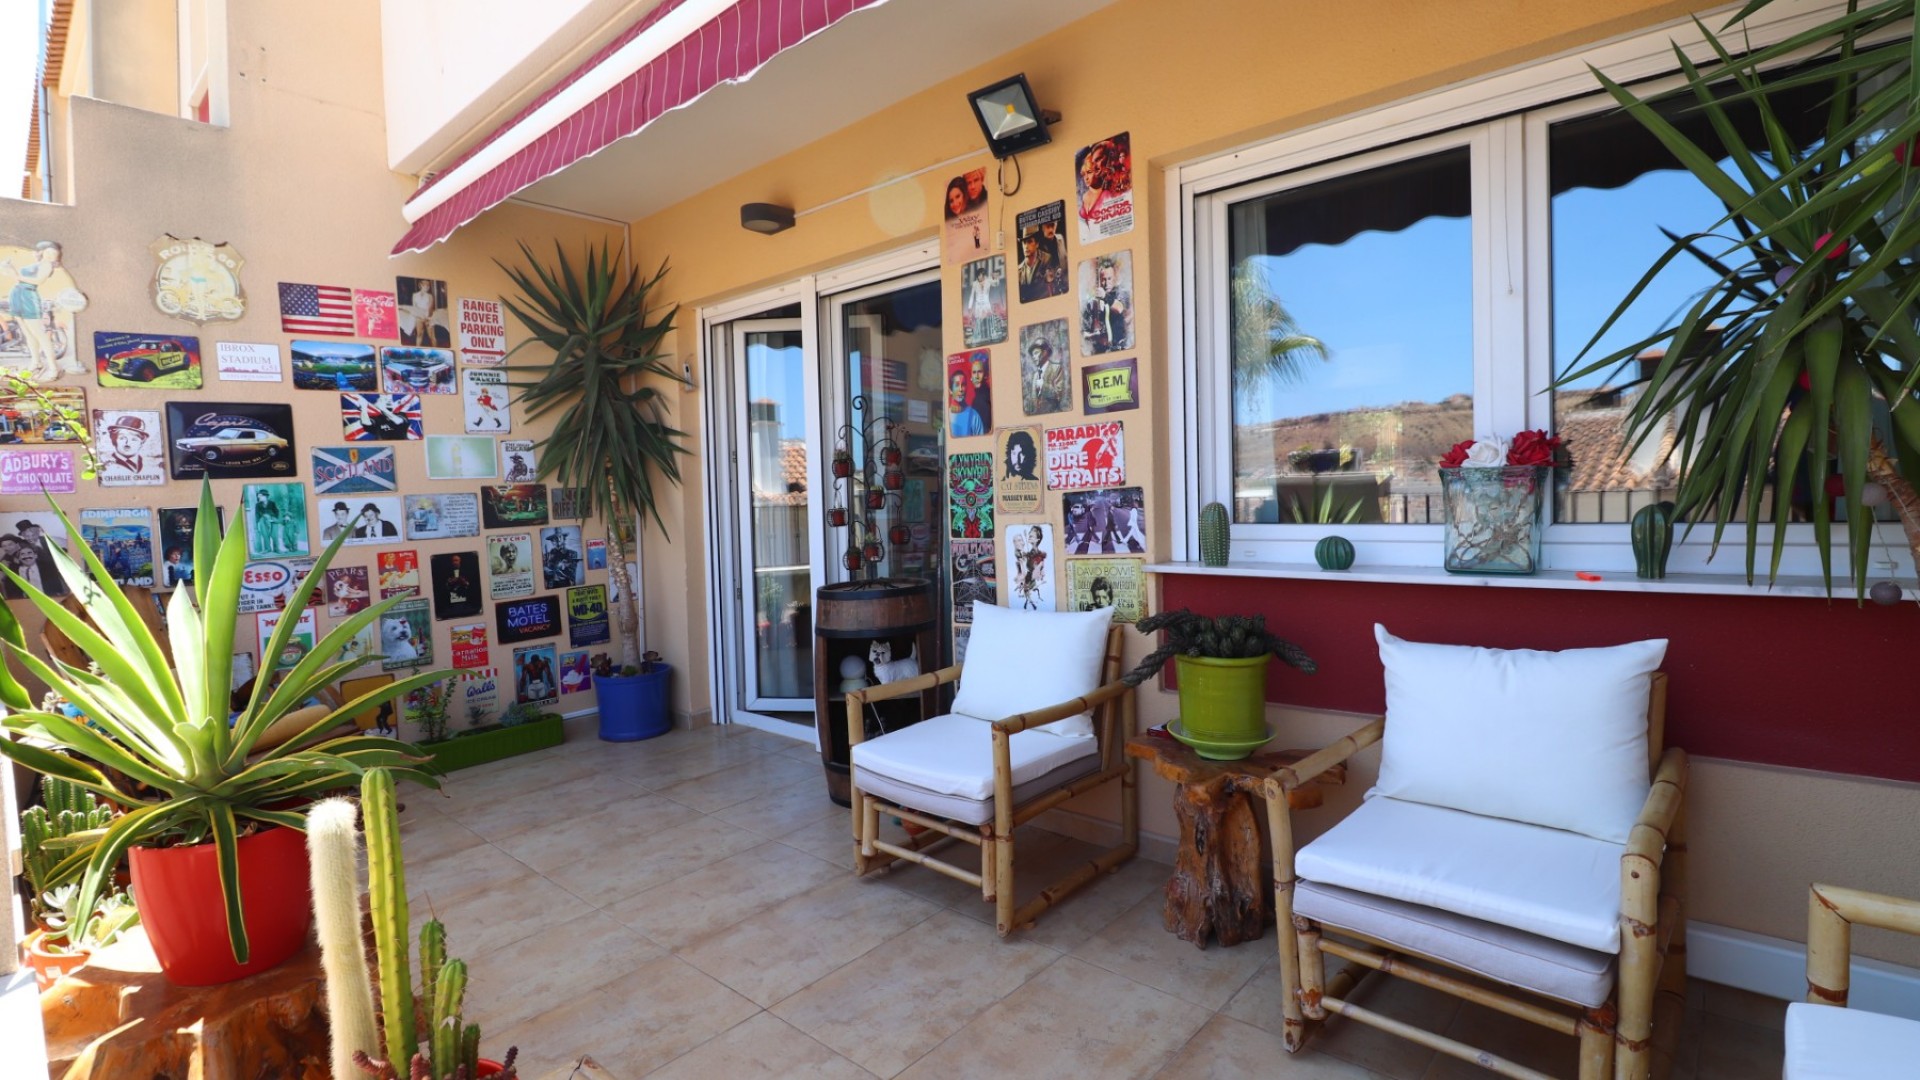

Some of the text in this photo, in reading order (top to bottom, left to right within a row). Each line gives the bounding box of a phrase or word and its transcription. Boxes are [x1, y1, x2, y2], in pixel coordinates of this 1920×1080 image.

[463, 299, 498, 313] RANGE
[464, 311, 498, 324] ROVER
[460, 322, 504, 336] PARKING
[220, 343, 255, 352] IBROX
[470, 336, 495, 348] ONLY
[221, 355, 271, 364] STADIUM
[1092, 374, 1125, 390] R.E.M.
[195, 413, 250, 430] Capri
[1049, 451, 1089, 470] DIRE
[315, 457, 394, 482] SCOTLAND
[15, 471, 73, 484] CHOCOLATE
[1050, 466, 1122, 488] STRAITS
[490, 535, 527, 543] PSYCHO
[327, 567, 364, 581] PEARS
[1077, 566, 1135, 577] DAVID BOWIE
[509, 603, 548, 617] BATES
[507, 613, 551, 628] MOTEL
[519, 624, 551, 634] VACANCY
